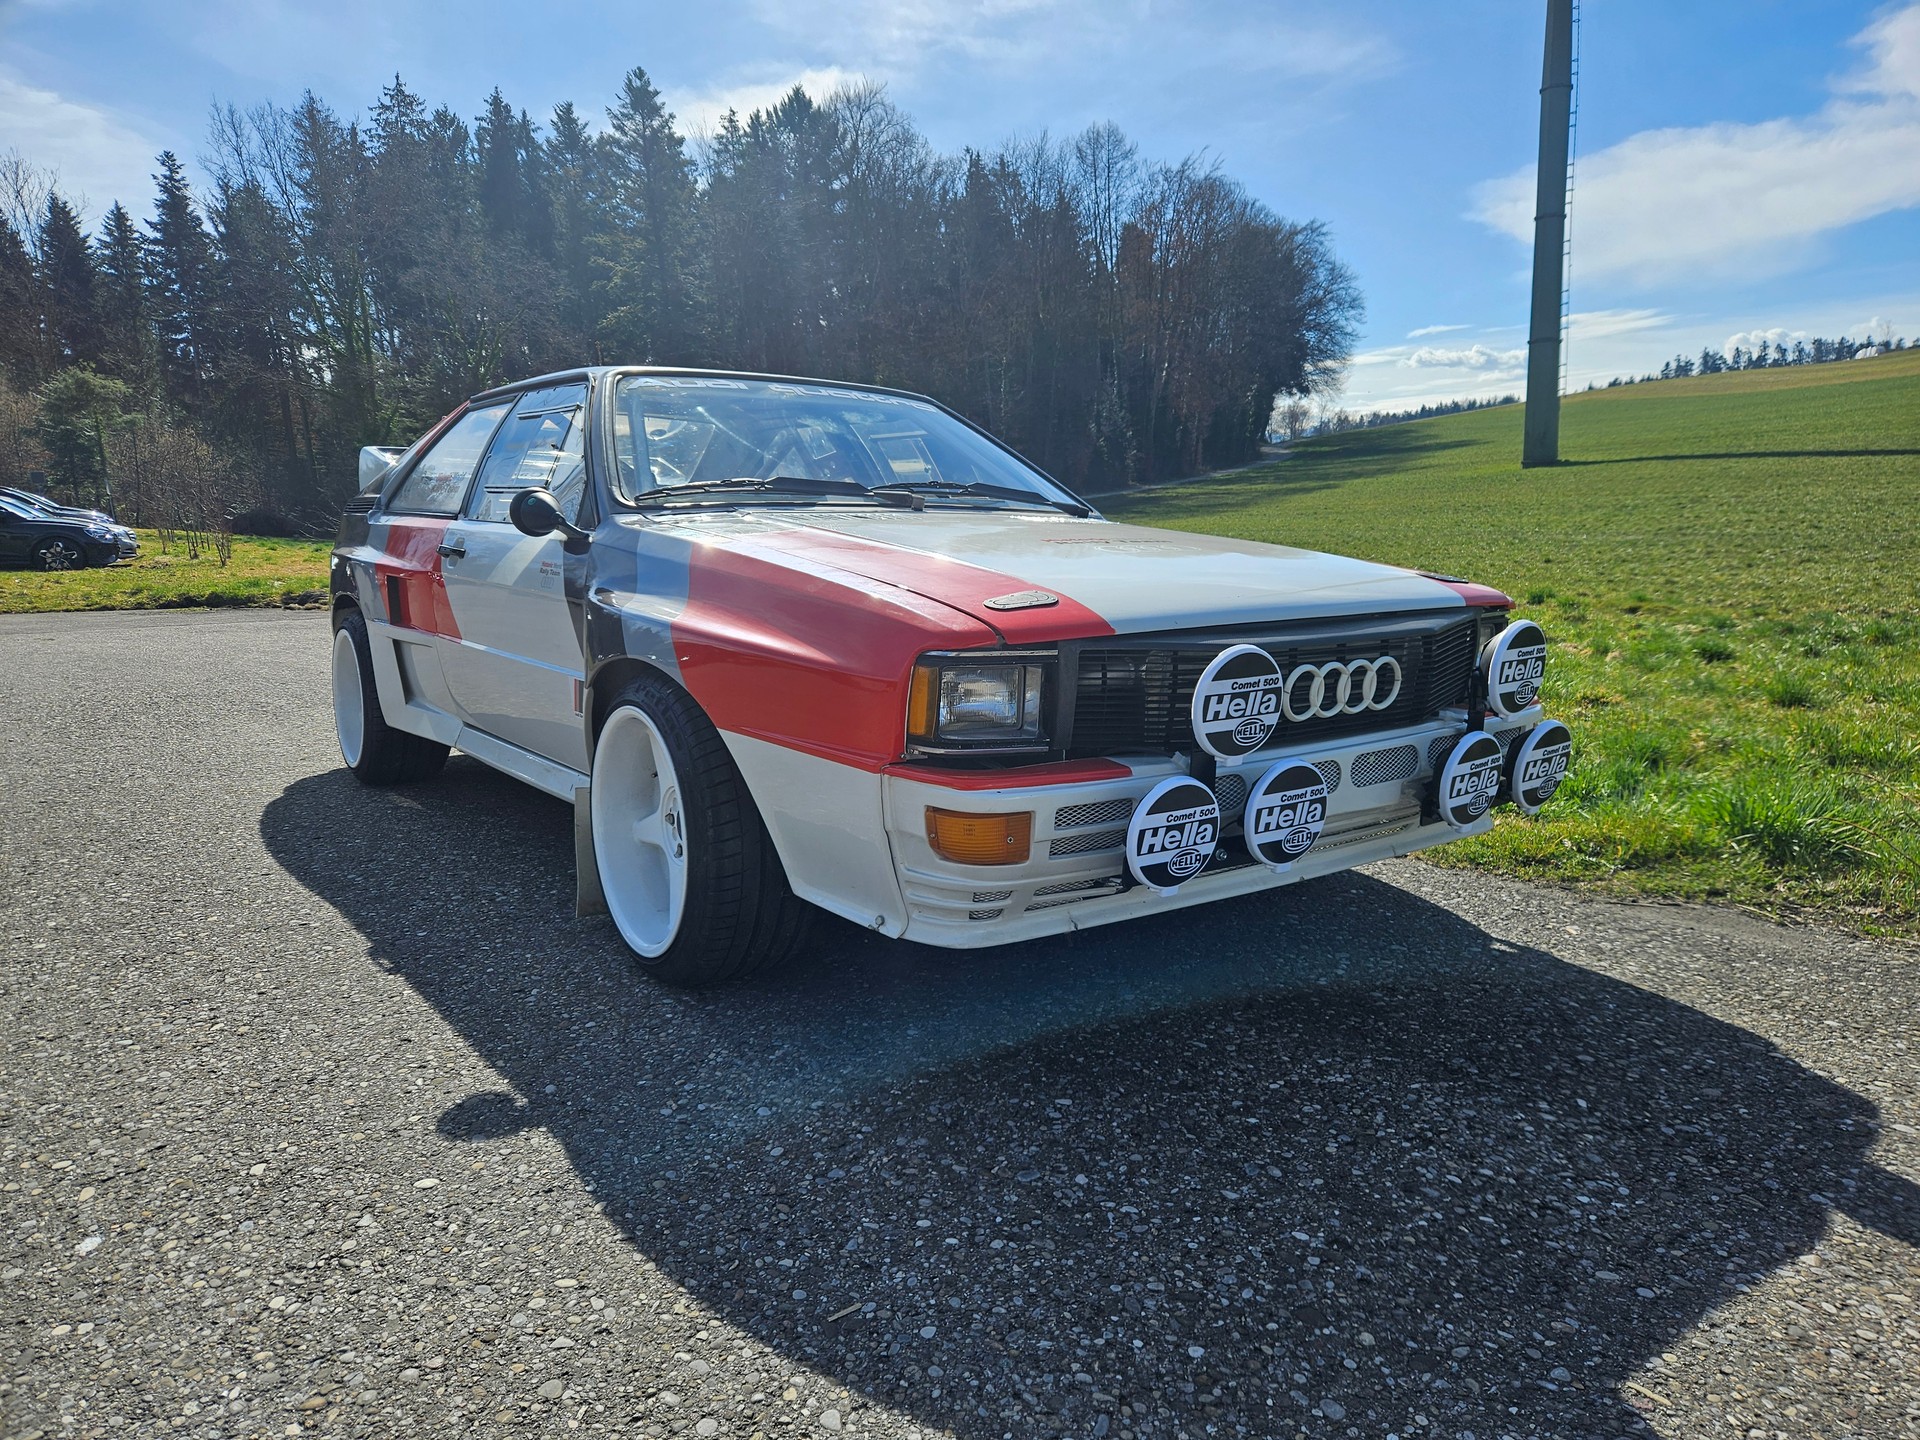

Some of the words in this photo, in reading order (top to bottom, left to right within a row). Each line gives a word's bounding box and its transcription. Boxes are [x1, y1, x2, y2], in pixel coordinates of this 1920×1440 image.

[1500, 658, 1543, 684] Hella
[1231, 679, 1261, 691] Comet
[1263, 677, 1279, 687] 500
[1205, 690, 1277, 721] Hella
[1236, 723, 1266, 737] HELLA
[1524, 755, 1567, 782] Hella
[1451, 768, 1498, 798] Hella
[1280, 791, 1308, 803] Comet
[1309, 787, 1324, 797] 500
[1166, 811, 1196, 823] Comet
[1199, 807, 1216, 817] 500
[1257, 801, 1323, 833] Hella
[1140, 821, 1213, 854] Hella
[1285, 832, 1312, 845] HELLA
[1171, 854, 1201, 868] HELLA
